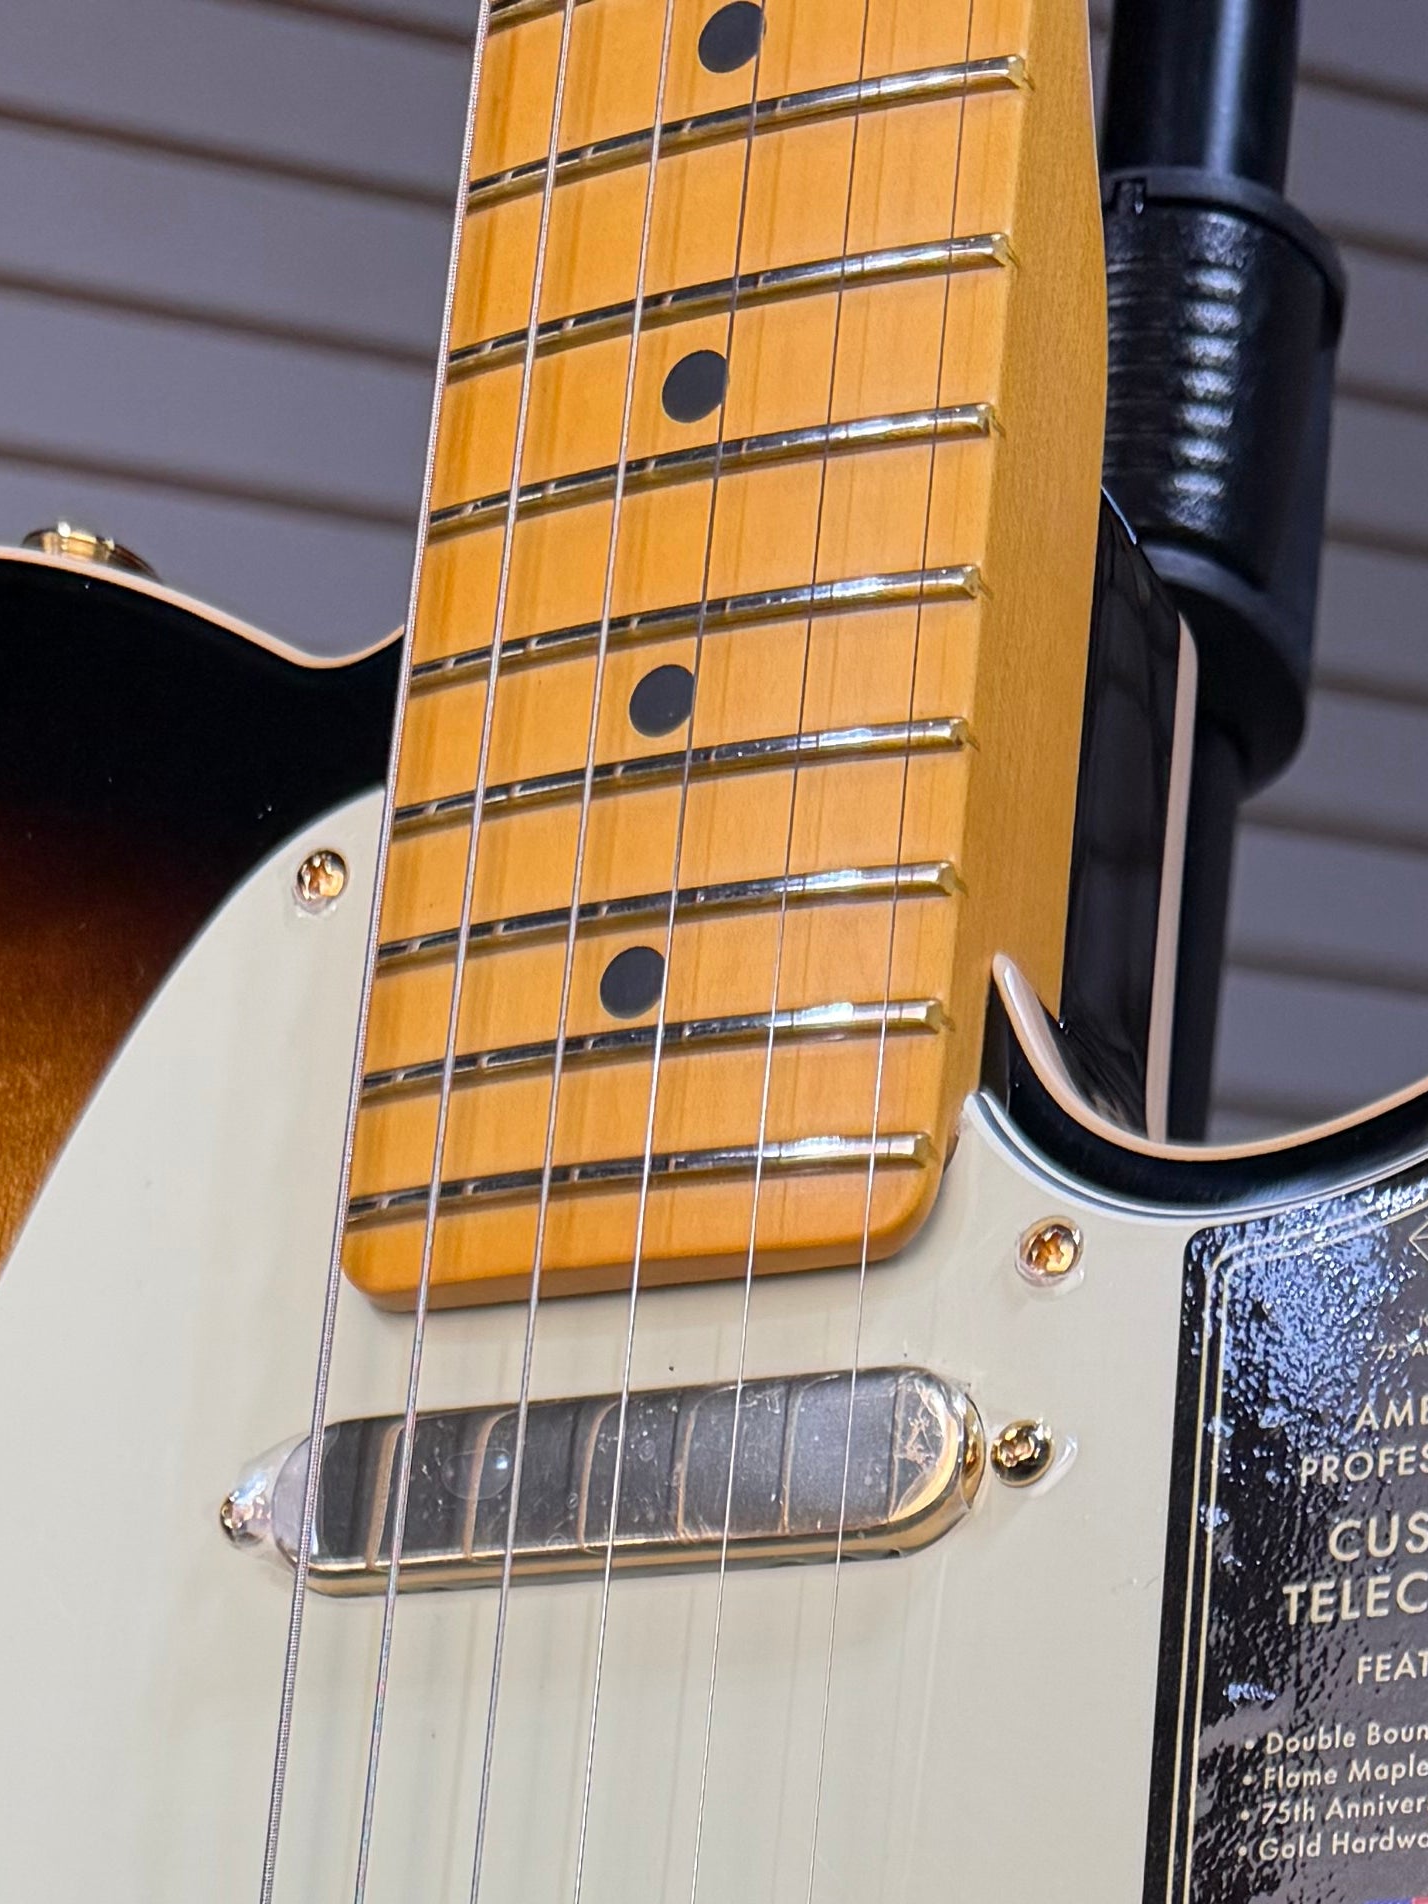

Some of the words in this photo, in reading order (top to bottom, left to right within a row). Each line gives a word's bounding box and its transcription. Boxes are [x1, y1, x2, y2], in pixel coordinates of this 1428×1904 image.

[1265, 1723, 1356, 1755] Double
[1263, 1766, 1338, 1790] Flame
[1261, 1799, 1315, 1826] 75th
[1258, 1832, 1321, 1861] Gold
